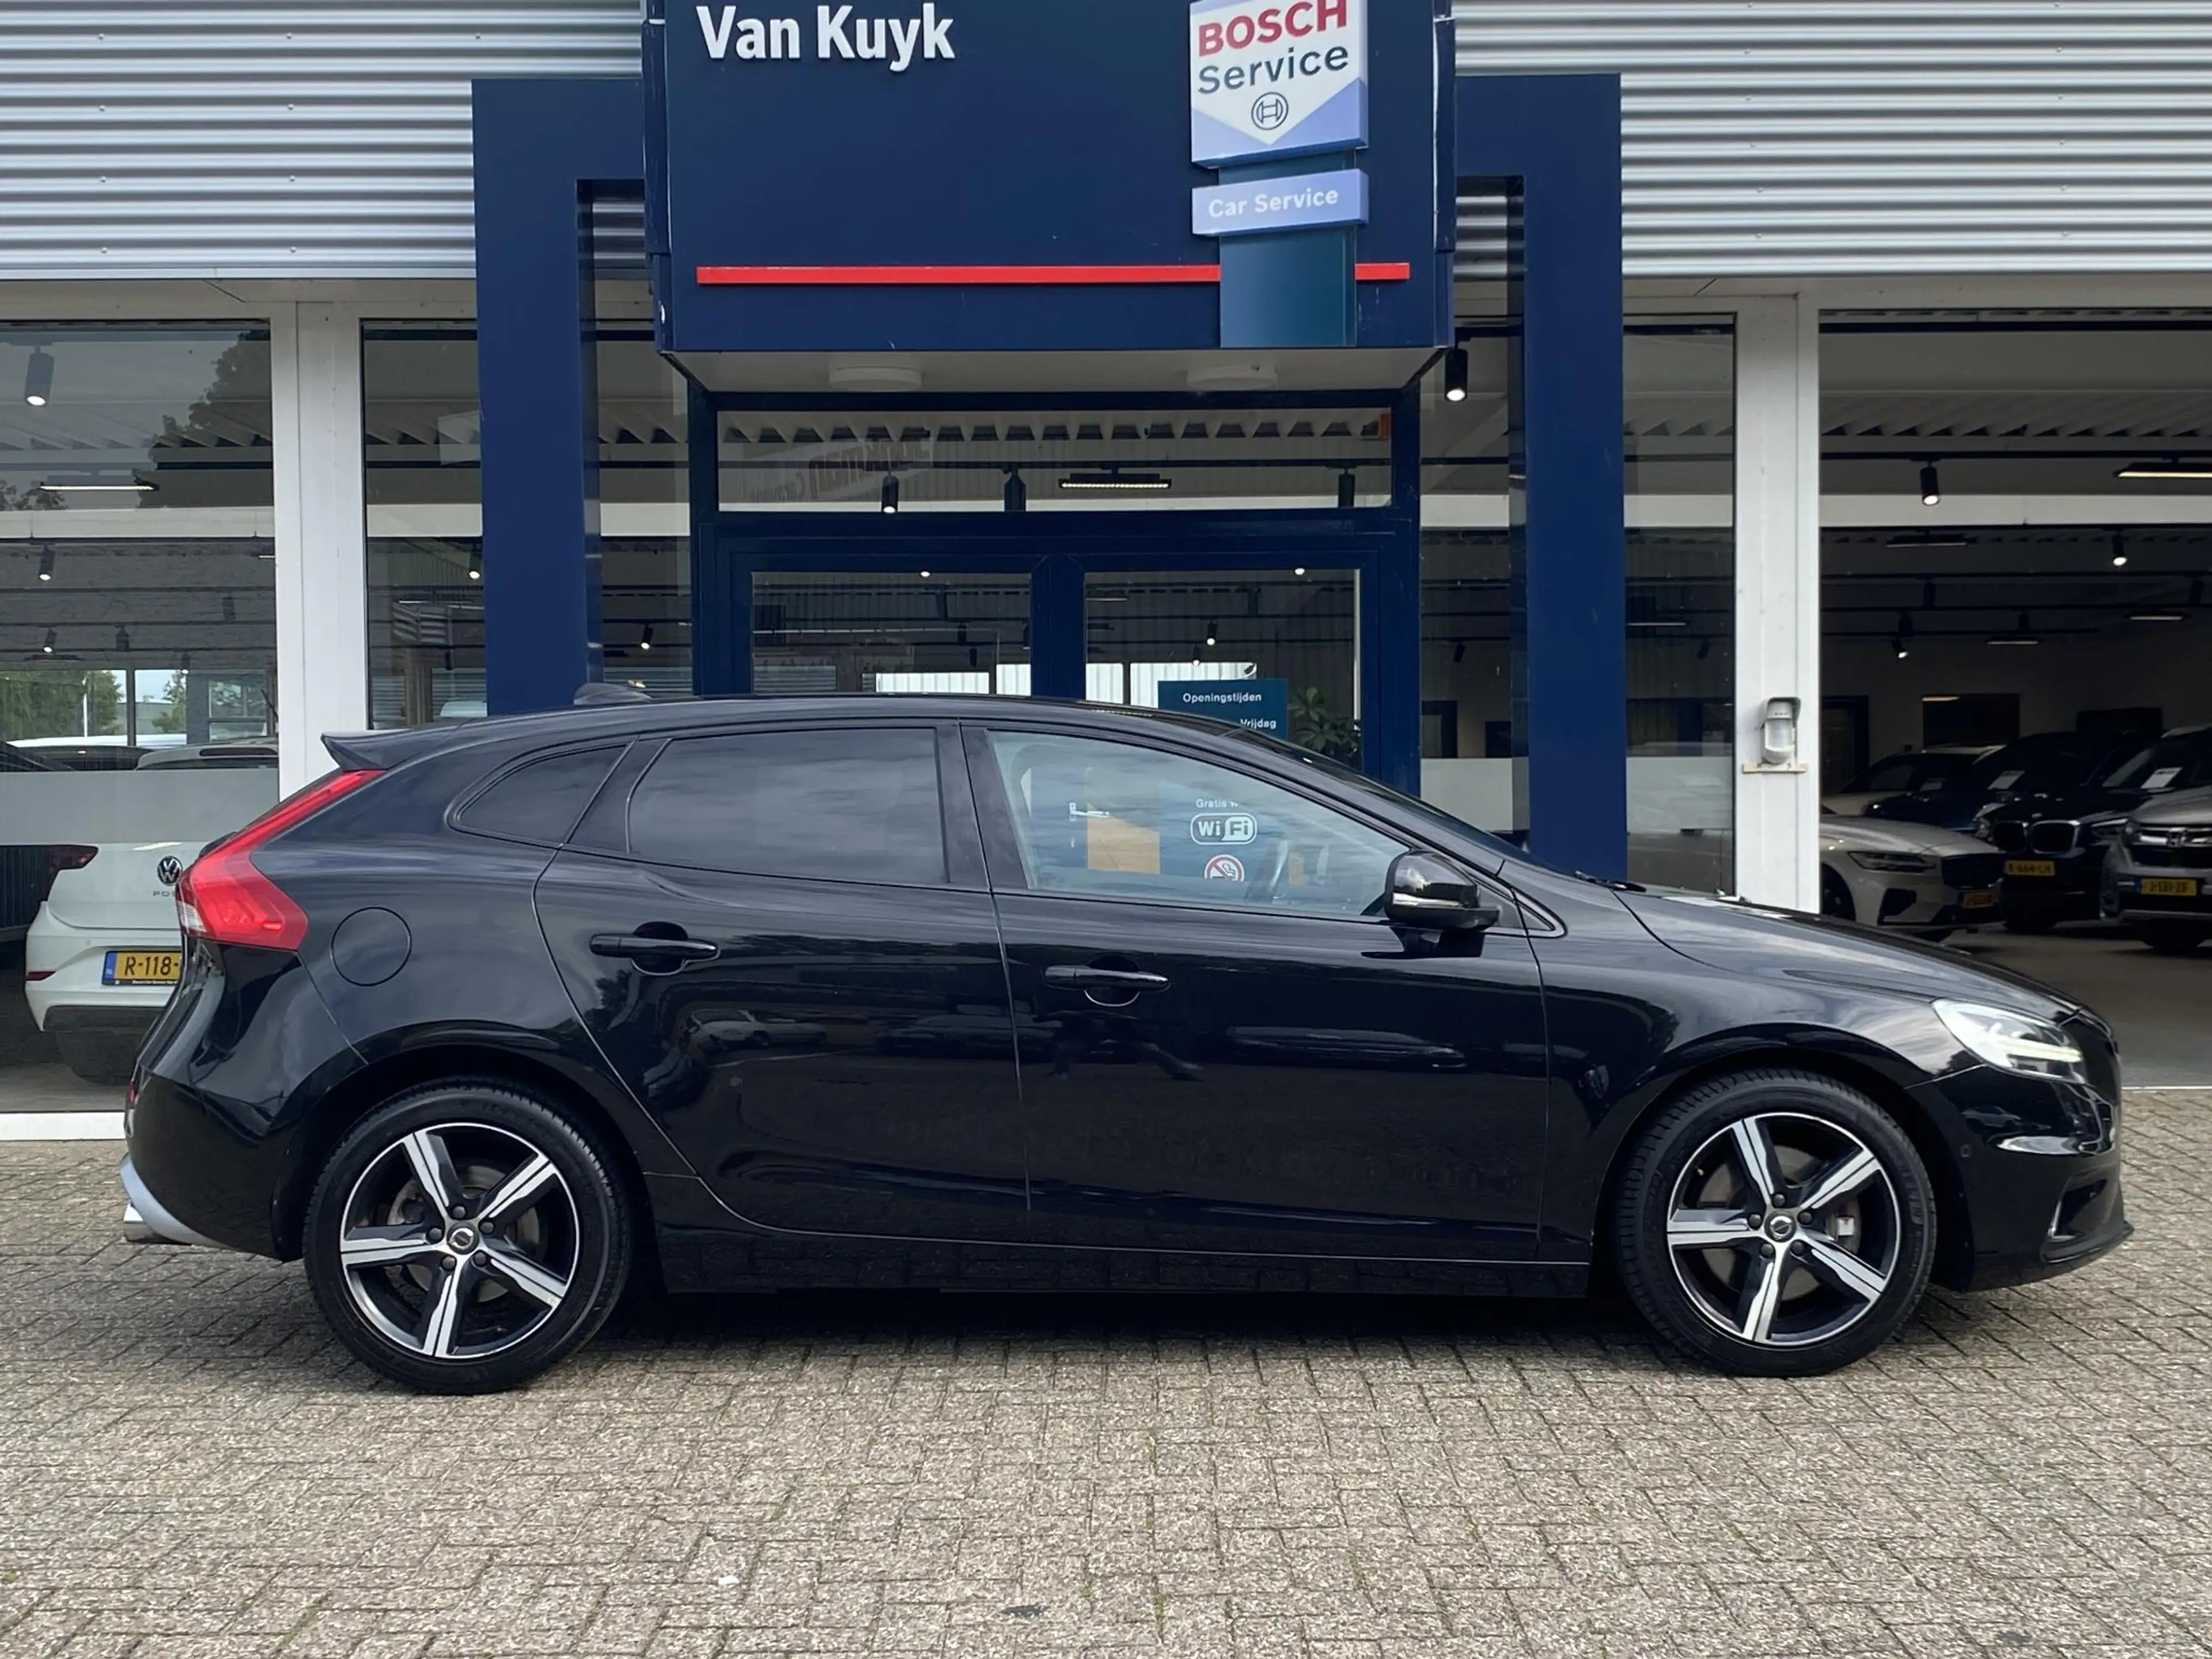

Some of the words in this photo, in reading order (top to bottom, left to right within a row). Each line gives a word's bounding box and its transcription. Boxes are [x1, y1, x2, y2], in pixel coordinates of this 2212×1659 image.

[696, 5, 801, 59] Van
[817, 2, 956, 72] Kuyk
[1198, 0, 1347, 57] BOSCH
[1198, 46, 1349, 94] Service
[1208, 199, 1247, 218] Car
[1254, 188, 1339, 213] Service
[1182, 692, 1262, 704] Openingstijden
[1195, 798, 1227, 809] Gratis
